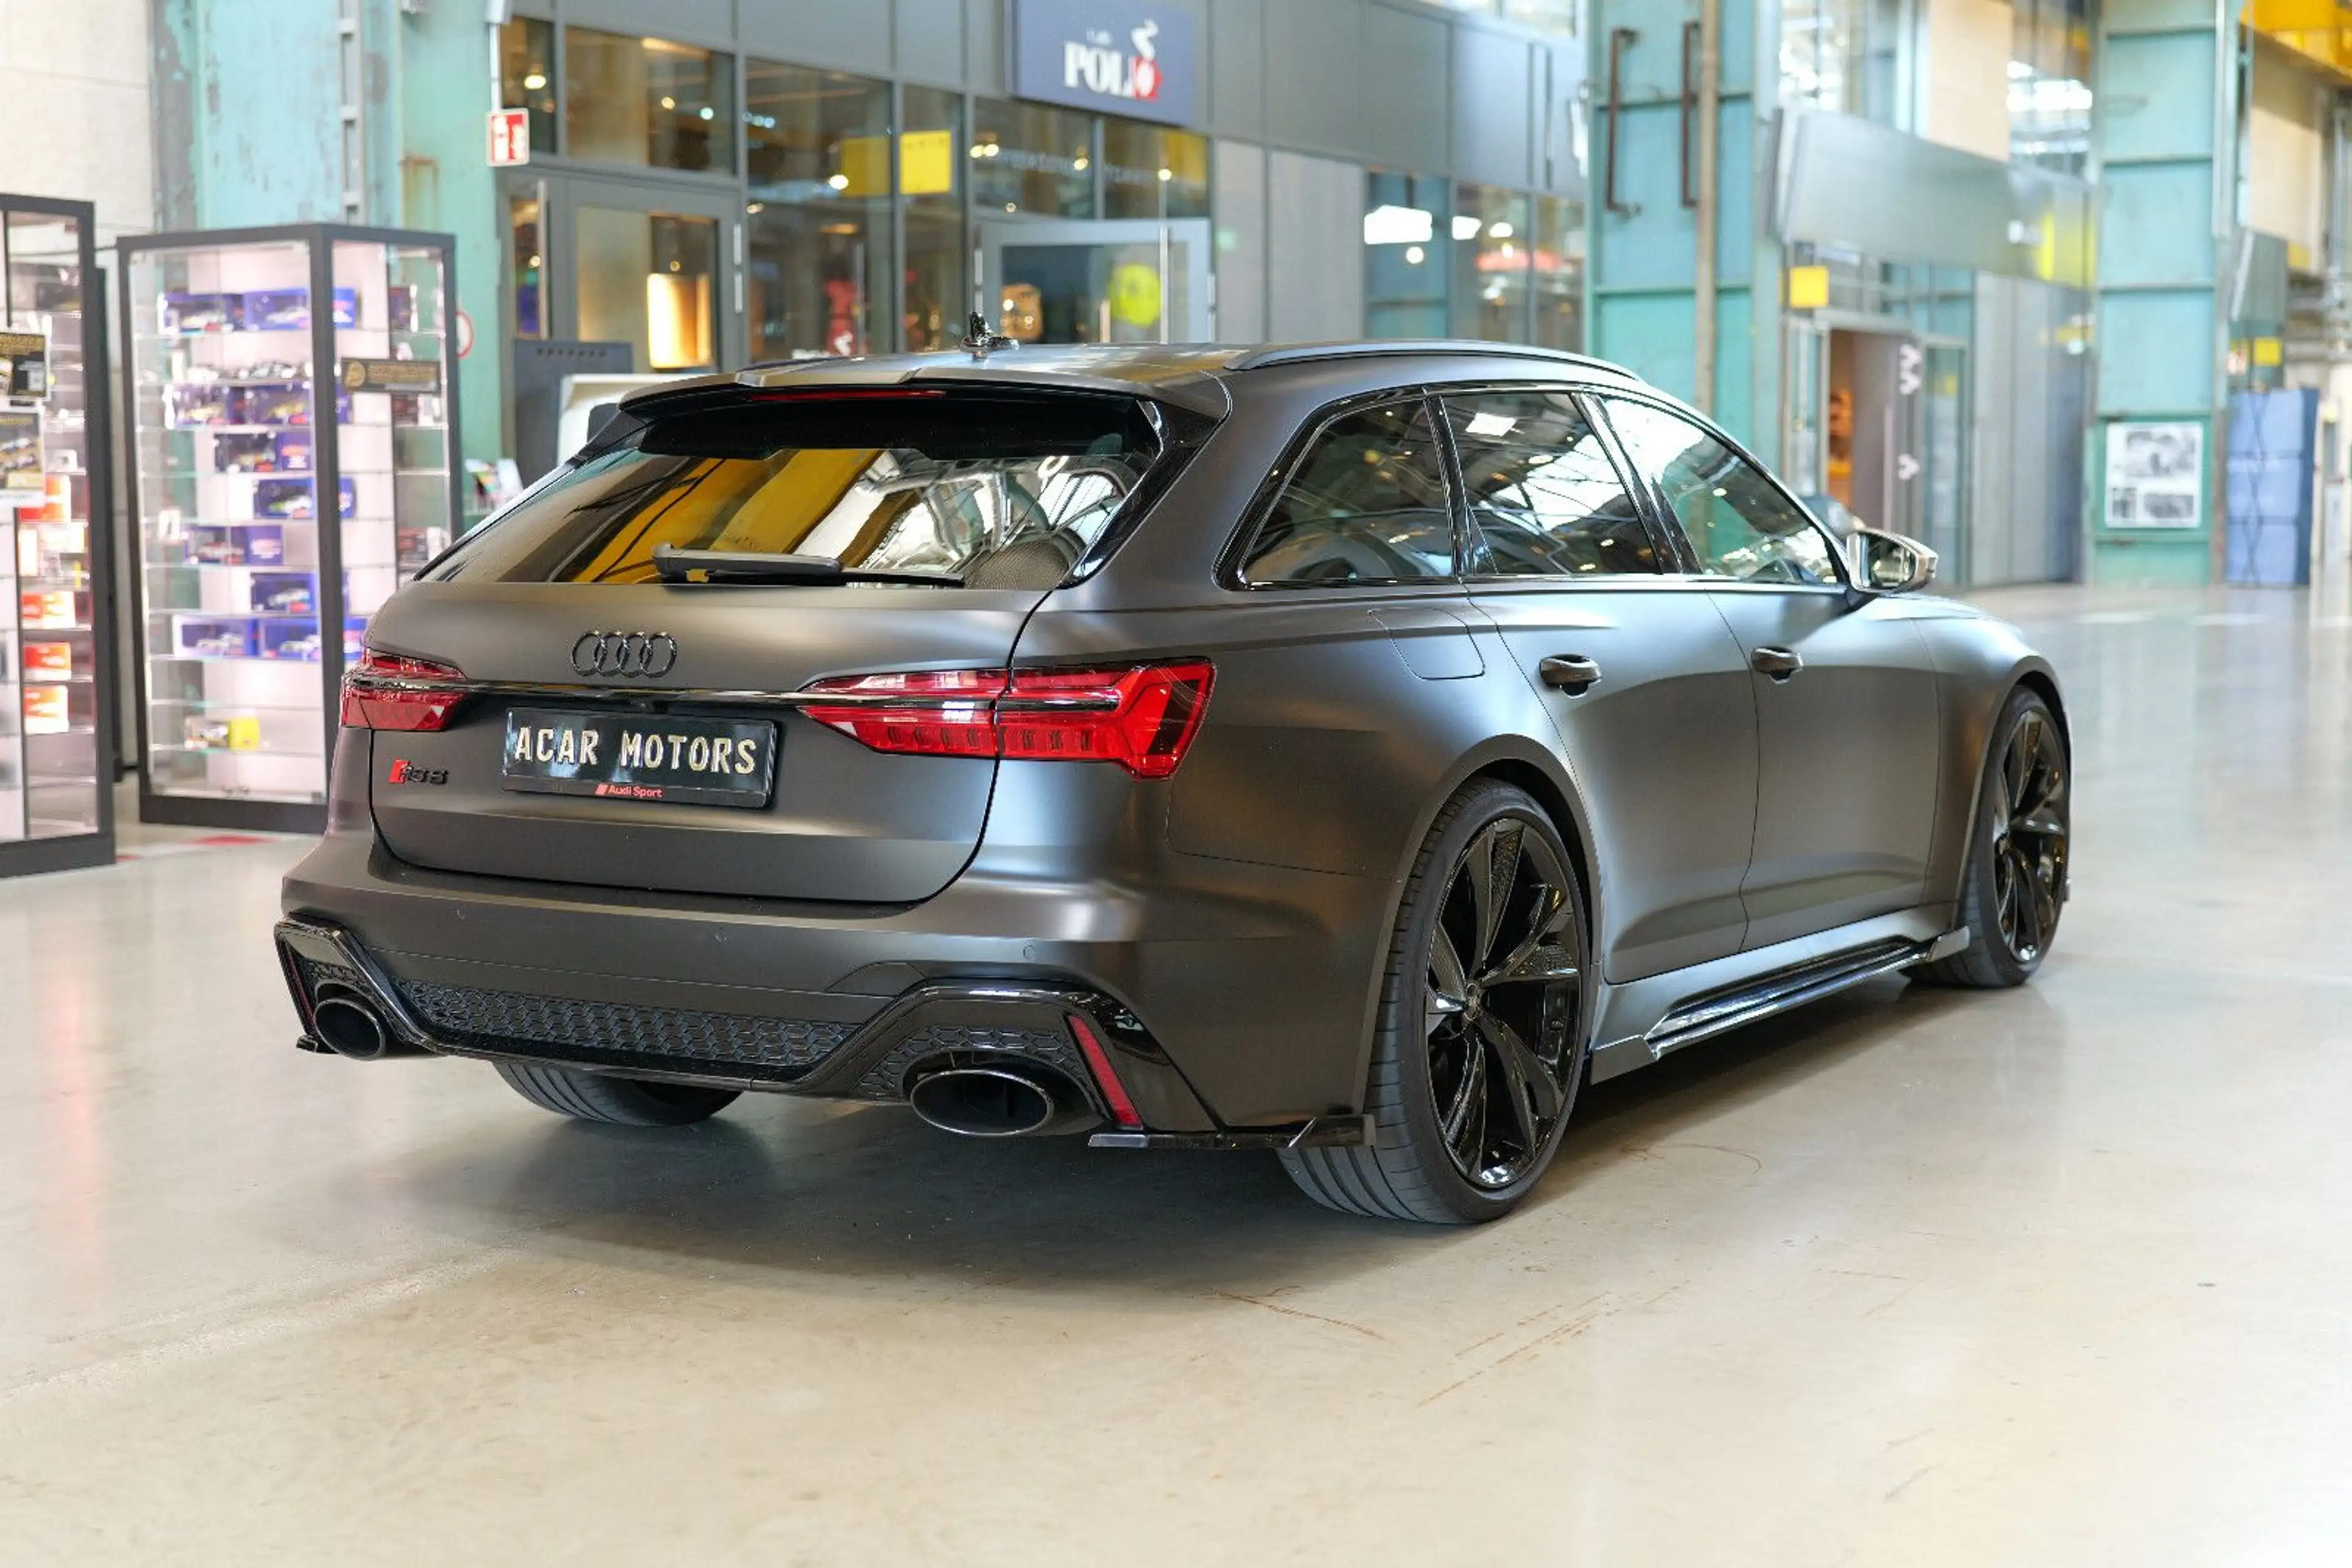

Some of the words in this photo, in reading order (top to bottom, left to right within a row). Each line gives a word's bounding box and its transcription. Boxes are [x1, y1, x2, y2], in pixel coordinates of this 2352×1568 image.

[514, 726, 599, 766] ACAR
[620, 731, 757, 774] MOTORS
[608, 785, 631, 796] Audi
[633, 786, 663, 799] Sport
